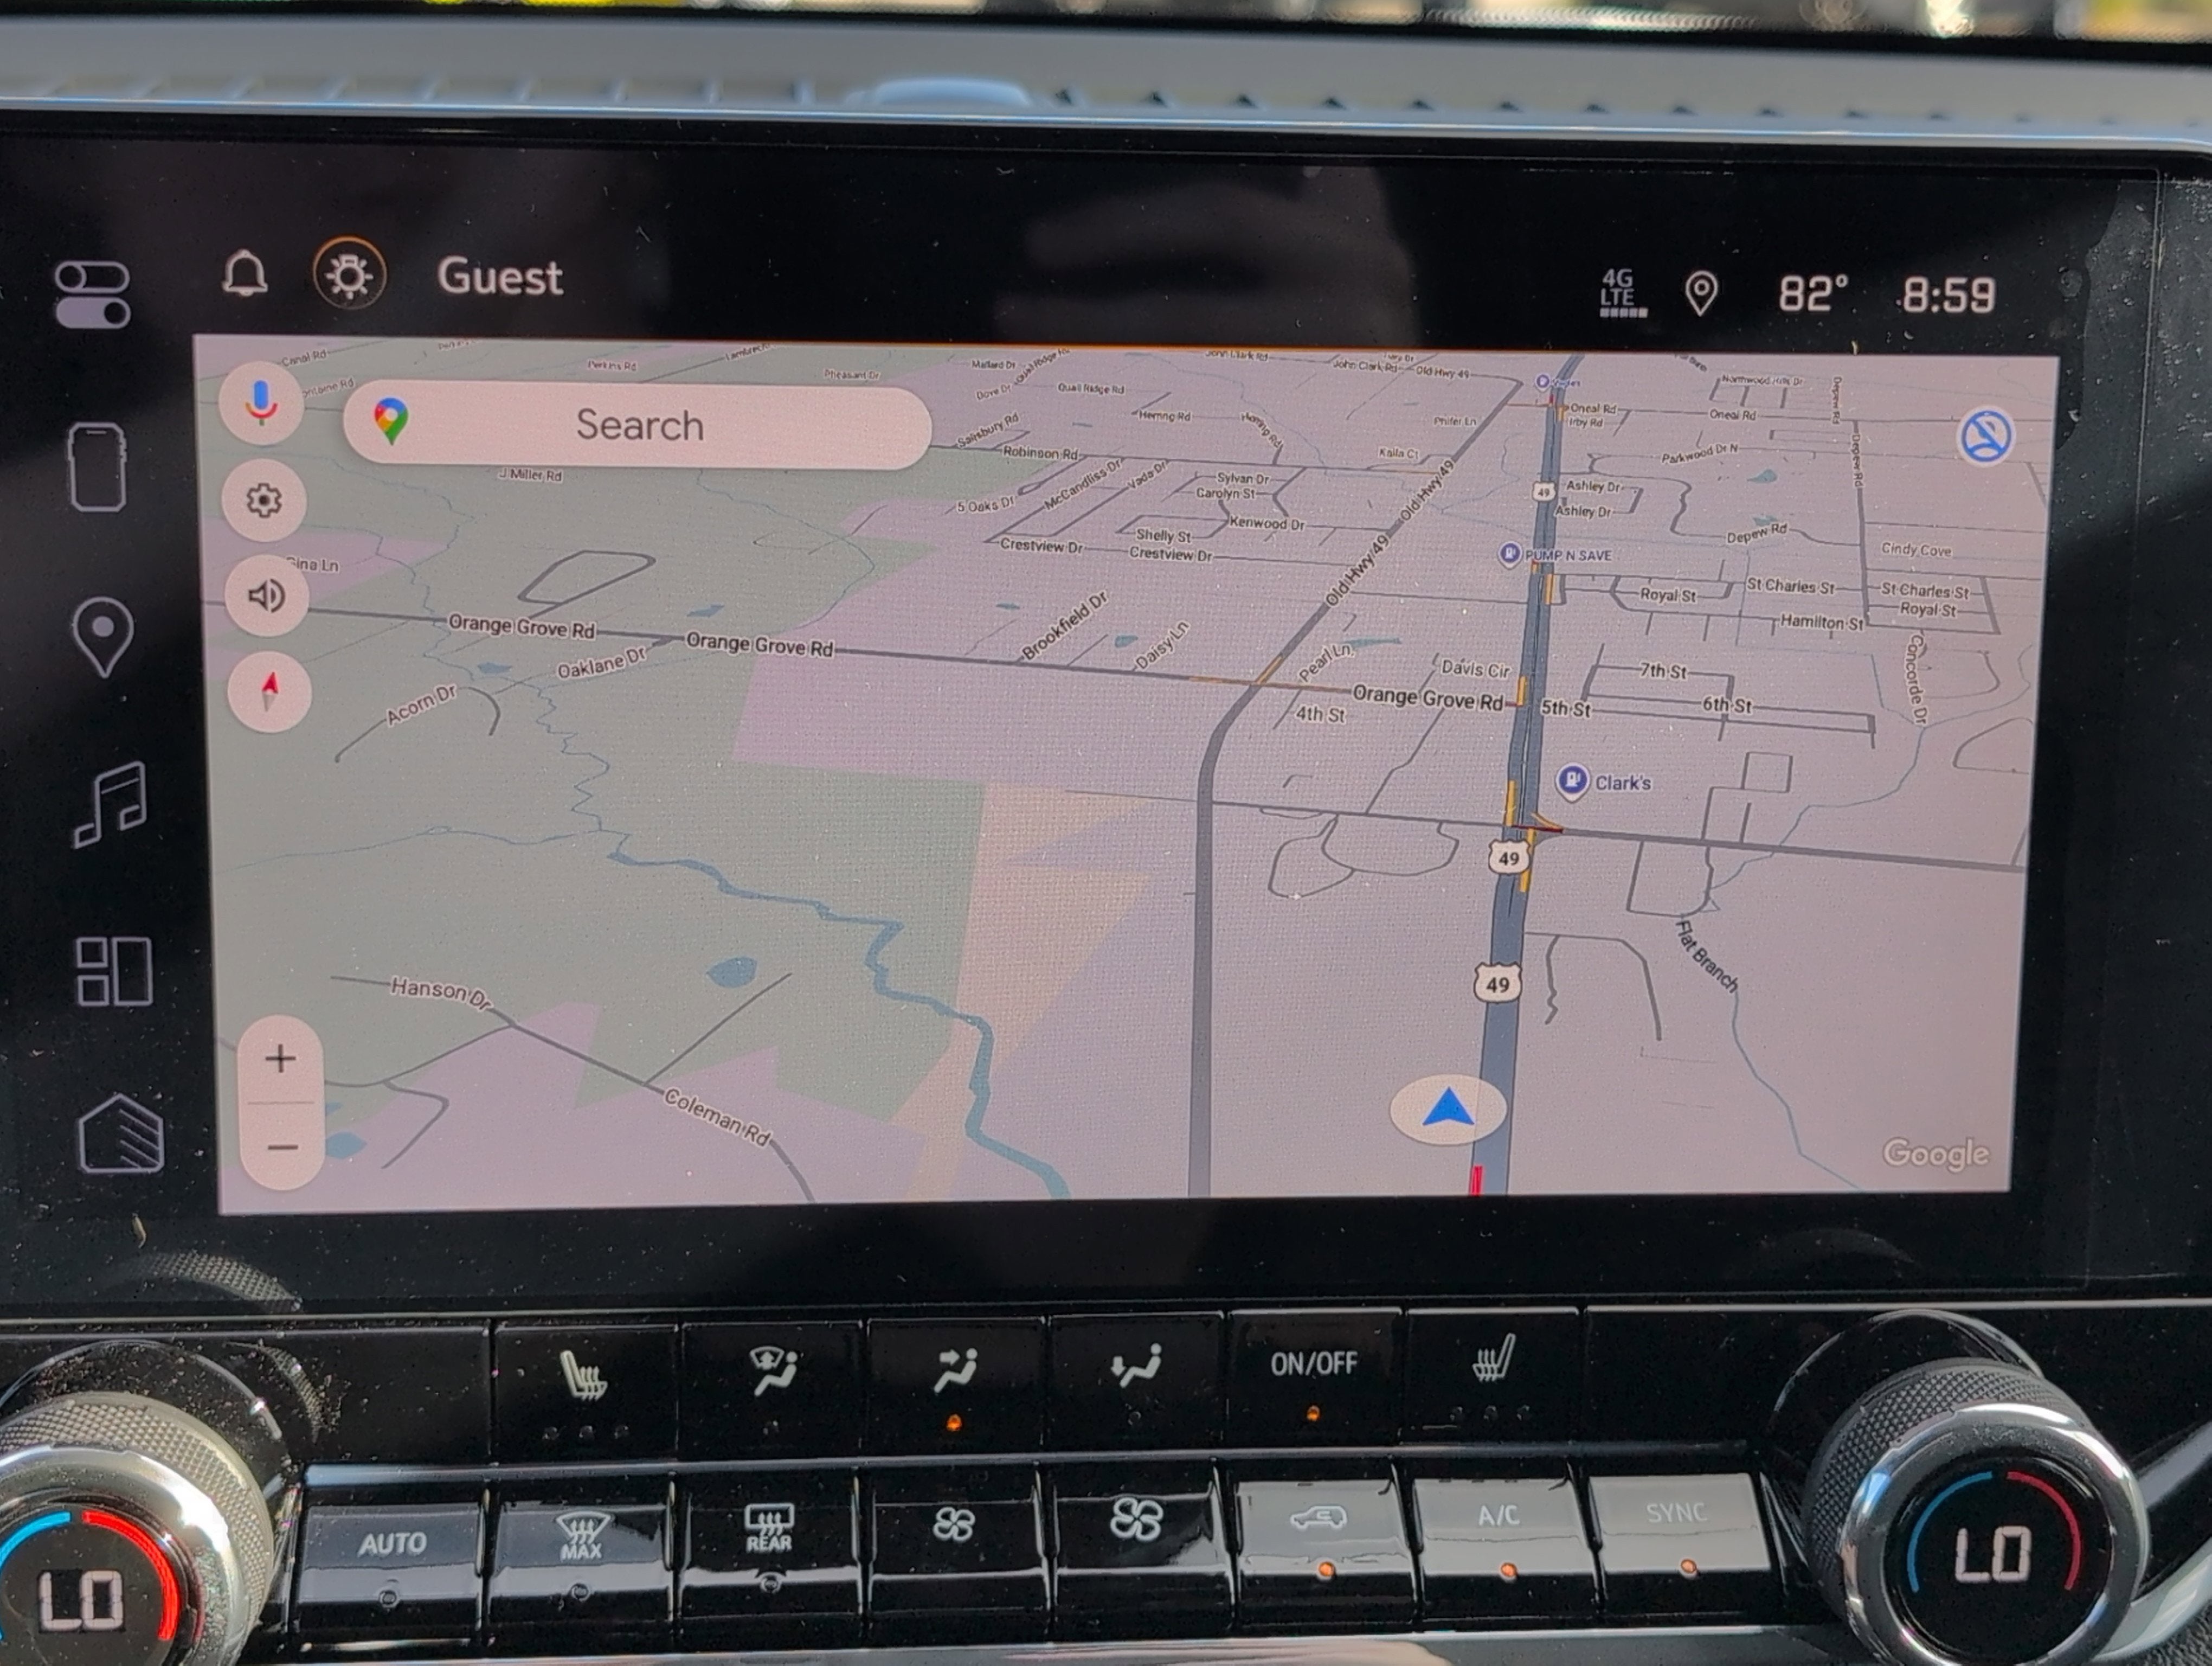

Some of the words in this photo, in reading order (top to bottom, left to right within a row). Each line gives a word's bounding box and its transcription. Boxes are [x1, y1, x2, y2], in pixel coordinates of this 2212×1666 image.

[438, 255, 564, 295] Guest
[1602, 268, 1633, 287] 4G
[1600, 288, 1635, 305] LTE
[1779, 274, 1849, 312] 82°
[1903, 276, 1997, 313] 8:59
[282, 351, 311, 367] Canal
[313, 349, 327, 360] Rd
[1006, 360, 1016, 369] Dr
[623, 362, 636, 371] Rd
[1333, 360, 1356, 369] John
[1359, 361, 1382, 372] Clark
[1385, 363, 1398, 373] Rd
[1416, 366, 1433, 376] Old
[1435, 368, 1456, 380] Hwy
[1458, 369, 1469, 379] 49
[869, 371, 880, 380] Dr
[1001, 383, 1011, 393] Dr
[1058, 382, 1082, 392] Quail
[1112, 385, 1124, 394] Rd
[1178, 411, 1191, 421] Rd
[1571, 402, 1600, 414] Oneal
[1603, 403, 1617, 414] Rd
[1709, 409, 1739, 420] Oneal
[1742, 411, 1757, 421] Rd
[576, 408, 704, 441] Search
[1004, 412, 1019, 426] Rd
[1465, 417, 1477, 426] Ln
[1569, 417, 1587, 428] Irby
[1590, 418, 1603, 428] Rd
[1003, 445, 1059, 459] Robinson
[1063, 448, 1078, 460] Rd
[1661, 445, 1714, 464] Parkwood
[1715, 444, 1727, 454] Dr
[1730, 443, 1739, 453] N
[1154, 460, 1167, 475] Dr
[546, 470, 562, 482] Rd
[1044, 469, 1107, 509] McCandliss
[1108, 458, 1122, 473] Dr
[1217, 473, 1253, 485] Sylvan
[1256, 475, 1269, 485] Dr
[1853, 472, 1863, 488] Rd
[1243, 489, 1256, 499] St
[1401, 498, 1420, 521] Old
[1418, 475, 1443, 503] Hwy
[1439, 459, 1455, 476] 49
[1538, 488, 1550, 497] 49
[1566, 480, 1607, 494] Ashley
[1608, 482, 1621, 492] Dr
[957, 502, 965, 511] 5
[1001, 495, 1014, 507] Dr
[1555, 505, 1596, 519] Ashley
[1598, 507, 1612, 518] Dr
[1230, 516, 1287, 530] Kenwood
[1291, 520, 1305, 530] Dr
[1137, 529, 1174, 543] Shelly
[1178, 532, 1191, 543] St
[1727, 527, 1769, 544] Depew
[1771, 523, 1787, 535] Rd
[1000, 539, 1064, 553] Crestview
[1069, 543, 1083, 554] Dr
[1129, 547, 1193, 561] Crestview
[1198, 550, 1212, 562] Dr
[1882, 542, 1918, 558] Cindy
[1920, 544, 1952, 557] Cove
[1526, 550, 1563, 561] PUMP
[1566, 551, 1576, 561] N
[1579, 550, 1612, 562] SAVE
[321, 559, 339, 572] Ln
[1326, 580, 1350, 606] Old
[1347, 553, 1374, 585] Hwy
[1372, 535, 1390, 555] 49
[1747, 578, 1761, 591] St
[1765, 579, 1816, 594] Charles
[1820, 583, 1835, 594] St
[1882, 583, 1896, 595] St
[1899, 584, 1950, 599] Charles
[1954, 587, 1969, 599] St
[1641, 587, 1678, 604] Royal
[1681, 591, 1696, 603] St
[1901, 602, 1938, 617] Royal
[1941, 605, 1957, 617] St
[449, 614, 511, 635] Orange
[517, 619, 567, 637] Grove
[573, 623, 595, 638] Rd
[1022, 603, 1090, 661] Brookfield
[1089, 591, 1108, 610] Dr
[1782, 614, 1843, 630] Hamilton
[1848, 618, 1864, 631] St
[686, 632, 750, 654] Orange
[755, 637, 805, 656] Grove
[811, 642, 833, 657] Rd
[1136, 637, 1173, 670] Daisy
[1171, 620, 1190, 641] Ln
[558, 655, 625, 678] Oaklane
[627, 647, 645, 665] Dr
[1299, 647, 1333, 682] Pearl
[1442, 661, 1483, 677] Davis
[1489, 664, 1509, 678] Cir
[1641, 663, 1664, 677] 7th
[1670, 665, 1686, 678] St
[1905, 635, 1924, 706] Concorde
[387, 697, 435, 725] Acorn
[435, 684, 456, 705] Dr
[1354, 685, 1418, 703] Orange
[1423, 690, 1475, 709] Grove
[1480, 695, 1503, 711] Rd
[1296, 706, 1323, 721] 4th
[1328, 709, 1346, 723] St
[1542, 702, 1568, 715] 5th
[1573, 705, 1591, 717] St
[1703, 699, 1729, 712] 6th
[1734, 700, 1752, 714] St
[1912, 708, 1928, 726] Dr
[1596, 776, 1651, 791] Clark's
[1499, 852, 1520, 866] 49
[1677, 920, 1696, 949] Flat
[1693, 947, 1739, 994] Branch
[1486, 977, 1509, 992] 49
[391, 977, 468, 1004] Hanson
[469, 989, 491, 1012] Dr
[664, 1088, 743, 1136] Coleman
[743, 1123, 771, 1148] Rd
[1883, 1137, 1990, 1172] Google
[1270, 1351, 1358, 1376] ON/OFF
[1478, 1503, 1517, 1527] A/C
[1647, 1502, 1708, 1523] SYNC
[358, 1532, 428, 1557] AUTO
[560, 1544, 602, 1560] MAX
[746, 1535, 792, 1553] REAR
[1955, 1526, 2032, 1584] LO
[39, 1571, 123, 1630] LO
